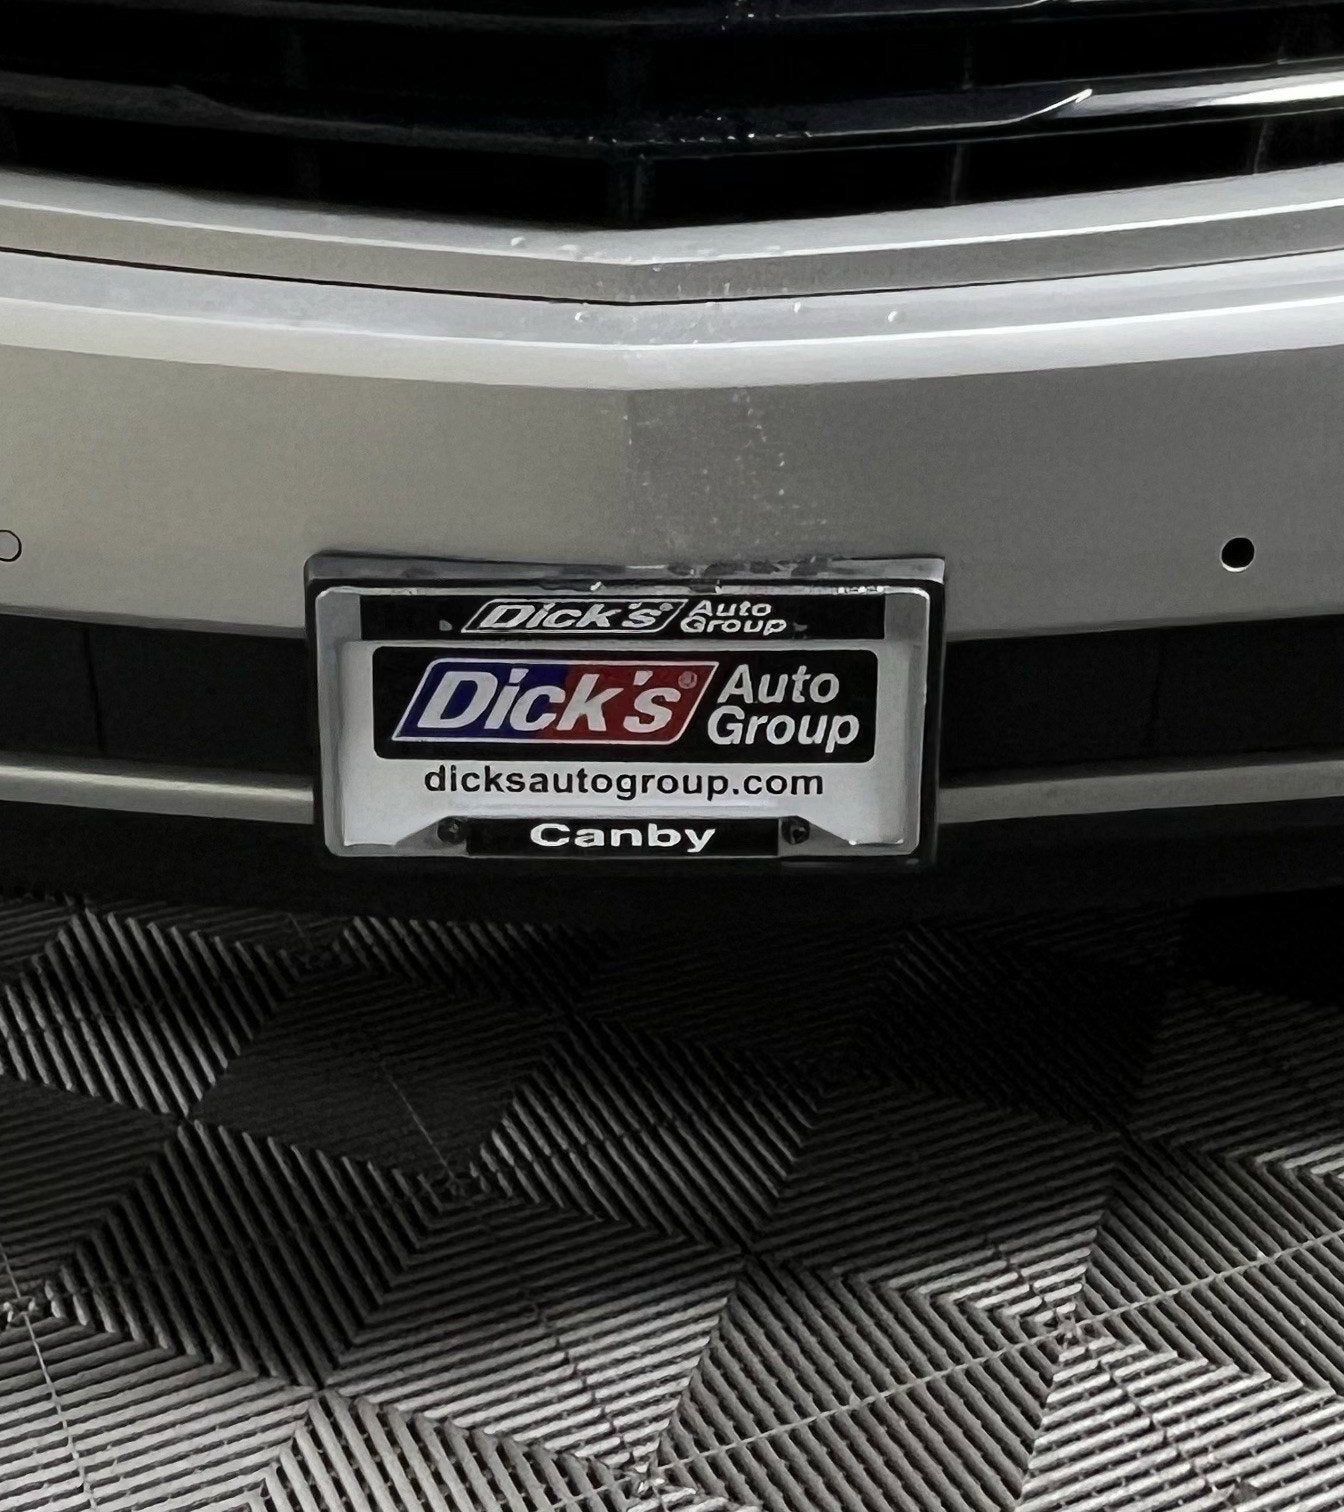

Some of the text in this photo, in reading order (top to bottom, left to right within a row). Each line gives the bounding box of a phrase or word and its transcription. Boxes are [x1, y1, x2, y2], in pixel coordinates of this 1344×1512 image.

[476, 600, 662, 629] Dick's
[680, 616, 787, 636] Group
[687, 599, 772, 617] Auto
[417, 668, 683, 733] Dick's
[717, 663, 841, 704] Auto
[707, 705, 860, 754] Group
[424, 764, 824, 802] dicksautogroup.com
[529, 821, 716, 855] Canby
